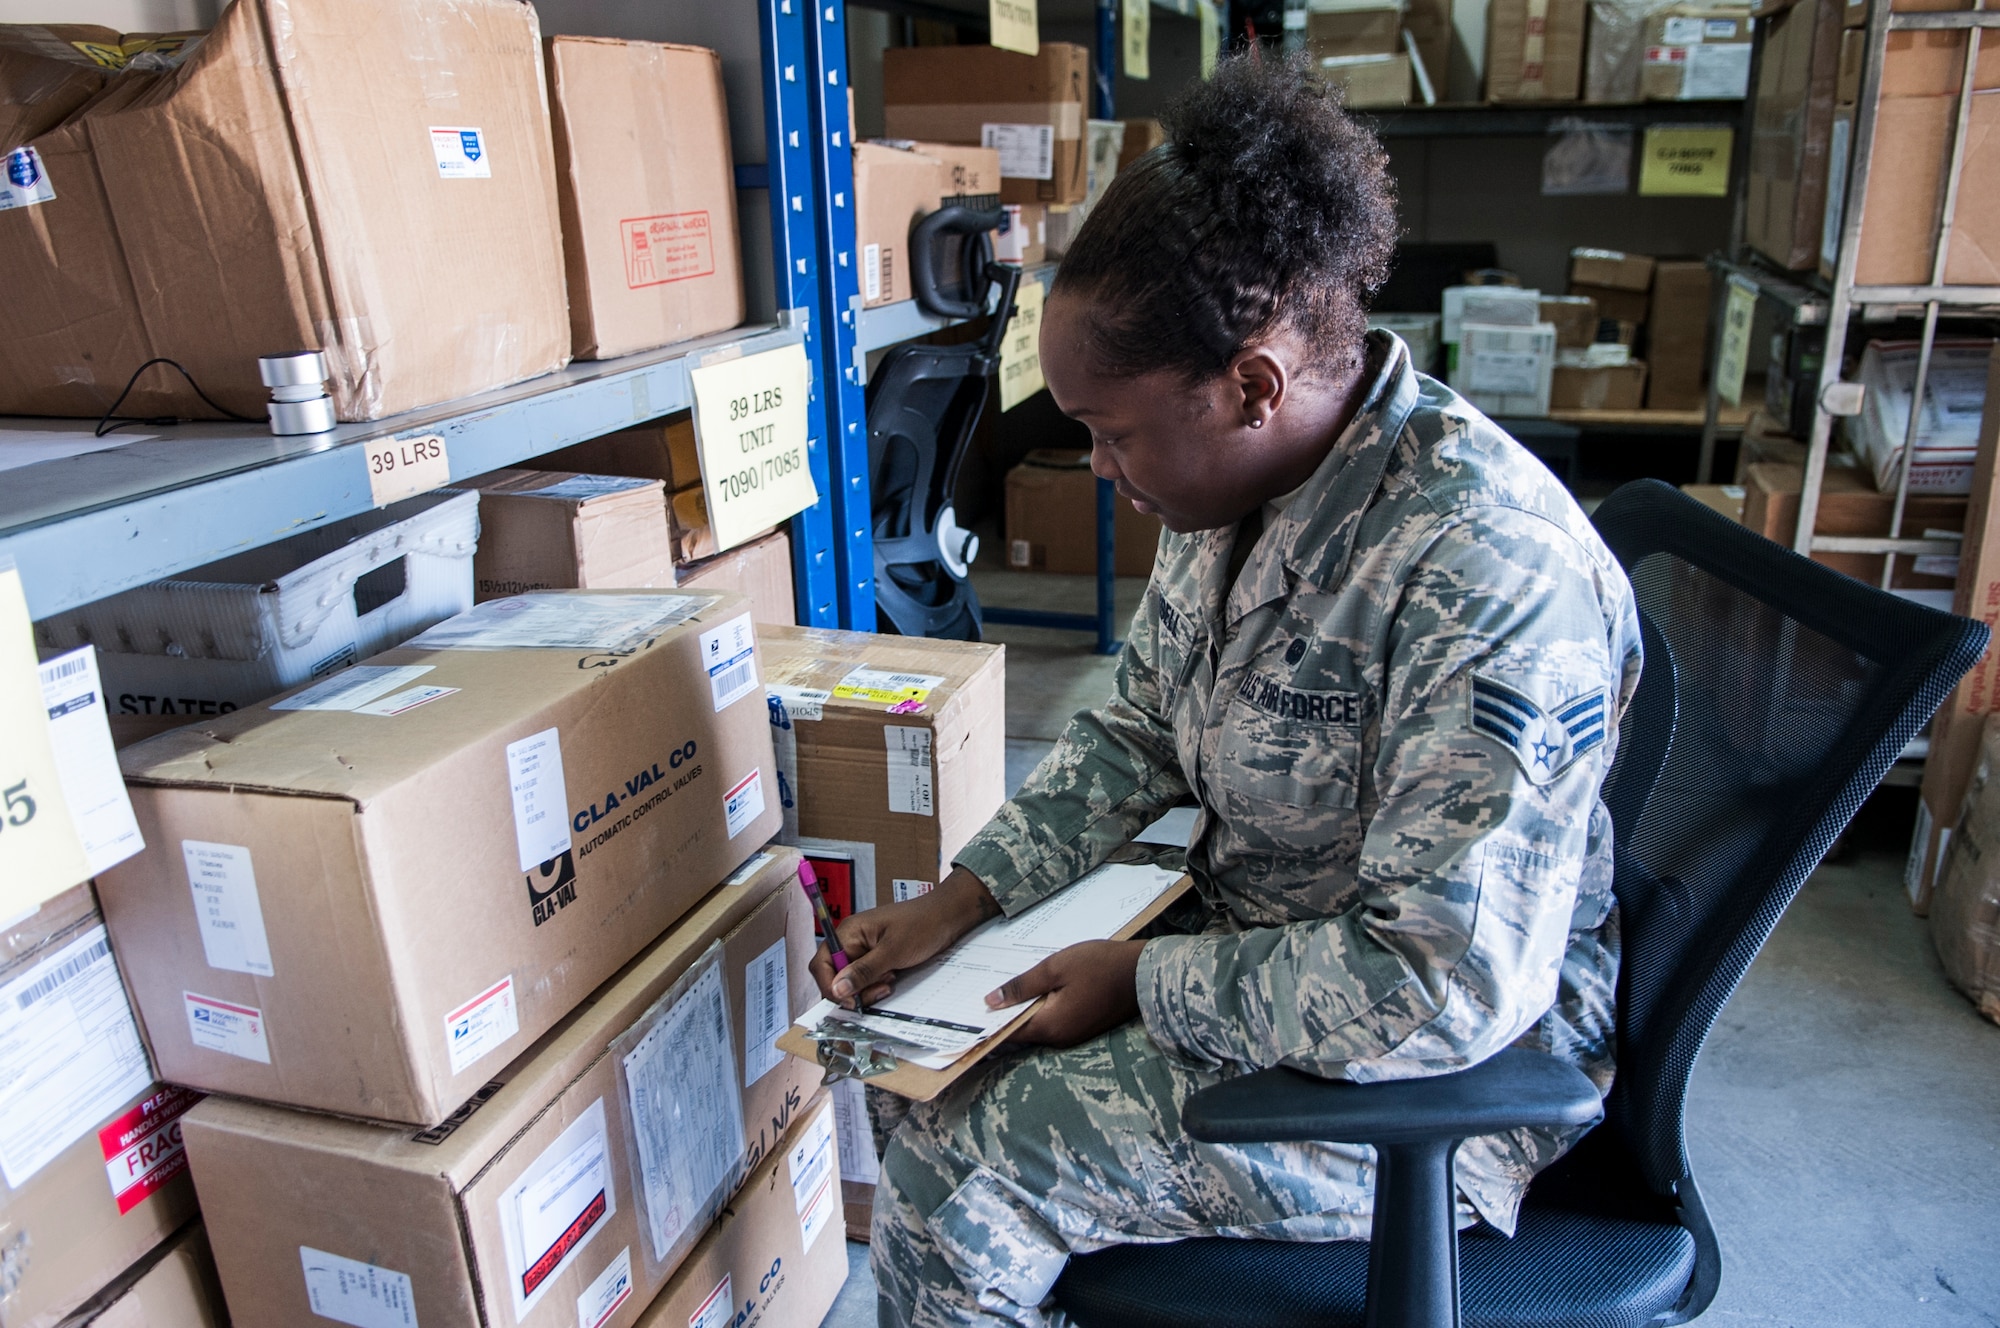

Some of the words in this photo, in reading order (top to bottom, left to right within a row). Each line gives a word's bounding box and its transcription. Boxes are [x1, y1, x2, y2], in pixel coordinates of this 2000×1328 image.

[729, 397, 749, 422] 39
[753, 387, 783, 415] LRS
[371, 450, 395, 474] 39
[401, 438, 441, 467] LRS
[739, 424, 775, 454] UNIT
[719, 448, 800, 503] 7090/7085
[1258, 680, 1281, 713] AIR
[1279, 689, 1364, 724] FORCE
[573, 763, 665, 833] CLA-VAL
[669, 739, 697, 769] CO
[579, 815, 632, 860] AUTOMATIC
[633, 786, 673, 820] CONTROL
[673, 765, 703, 792] VALVES
[532, 880, 578, 928] CLA-VAL
[120, 1114, 159, 1147] HANDLE
[160, 1100, 185, 1118] WITH
[731, 1299, 756, 1328] AL
[759, 1257, 781, 1293] CO
[761, 1274, 785, 1311] VALVES
